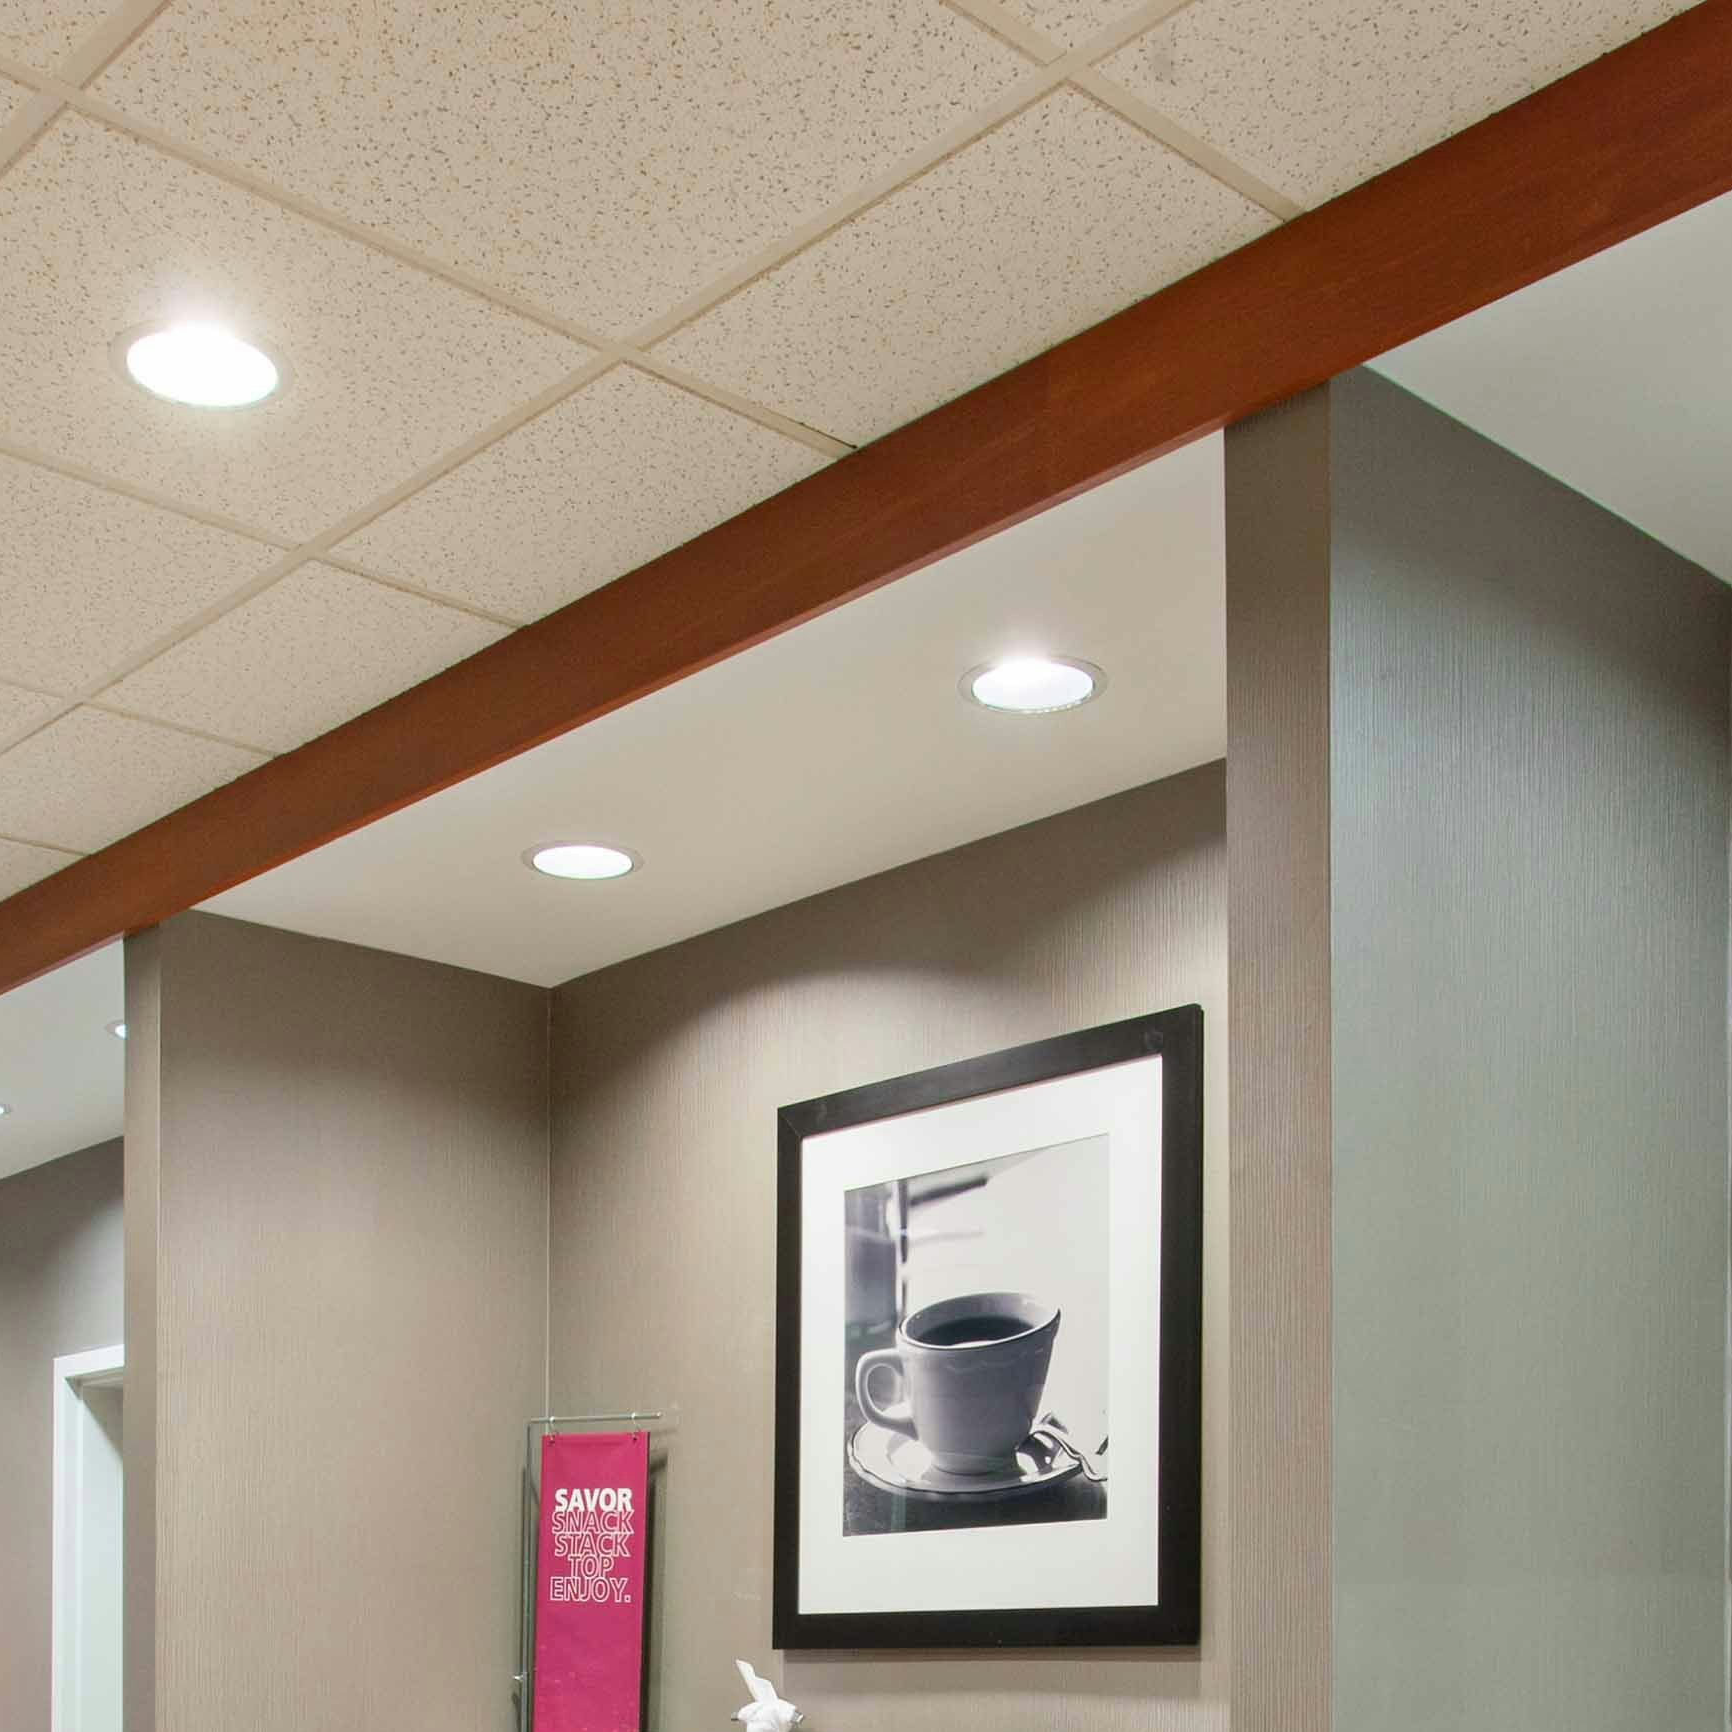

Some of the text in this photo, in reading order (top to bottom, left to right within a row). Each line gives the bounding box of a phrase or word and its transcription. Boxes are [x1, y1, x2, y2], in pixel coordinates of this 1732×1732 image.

[554, 1488, 633, 1512] SAVOR
[552, 1510, 634, 1534] SNACK
[554, 1532, 631, 1557] STACK
[568, 1554, 614, 1579] TOP
[550, 1576, 631, 1603] ENJOY.
